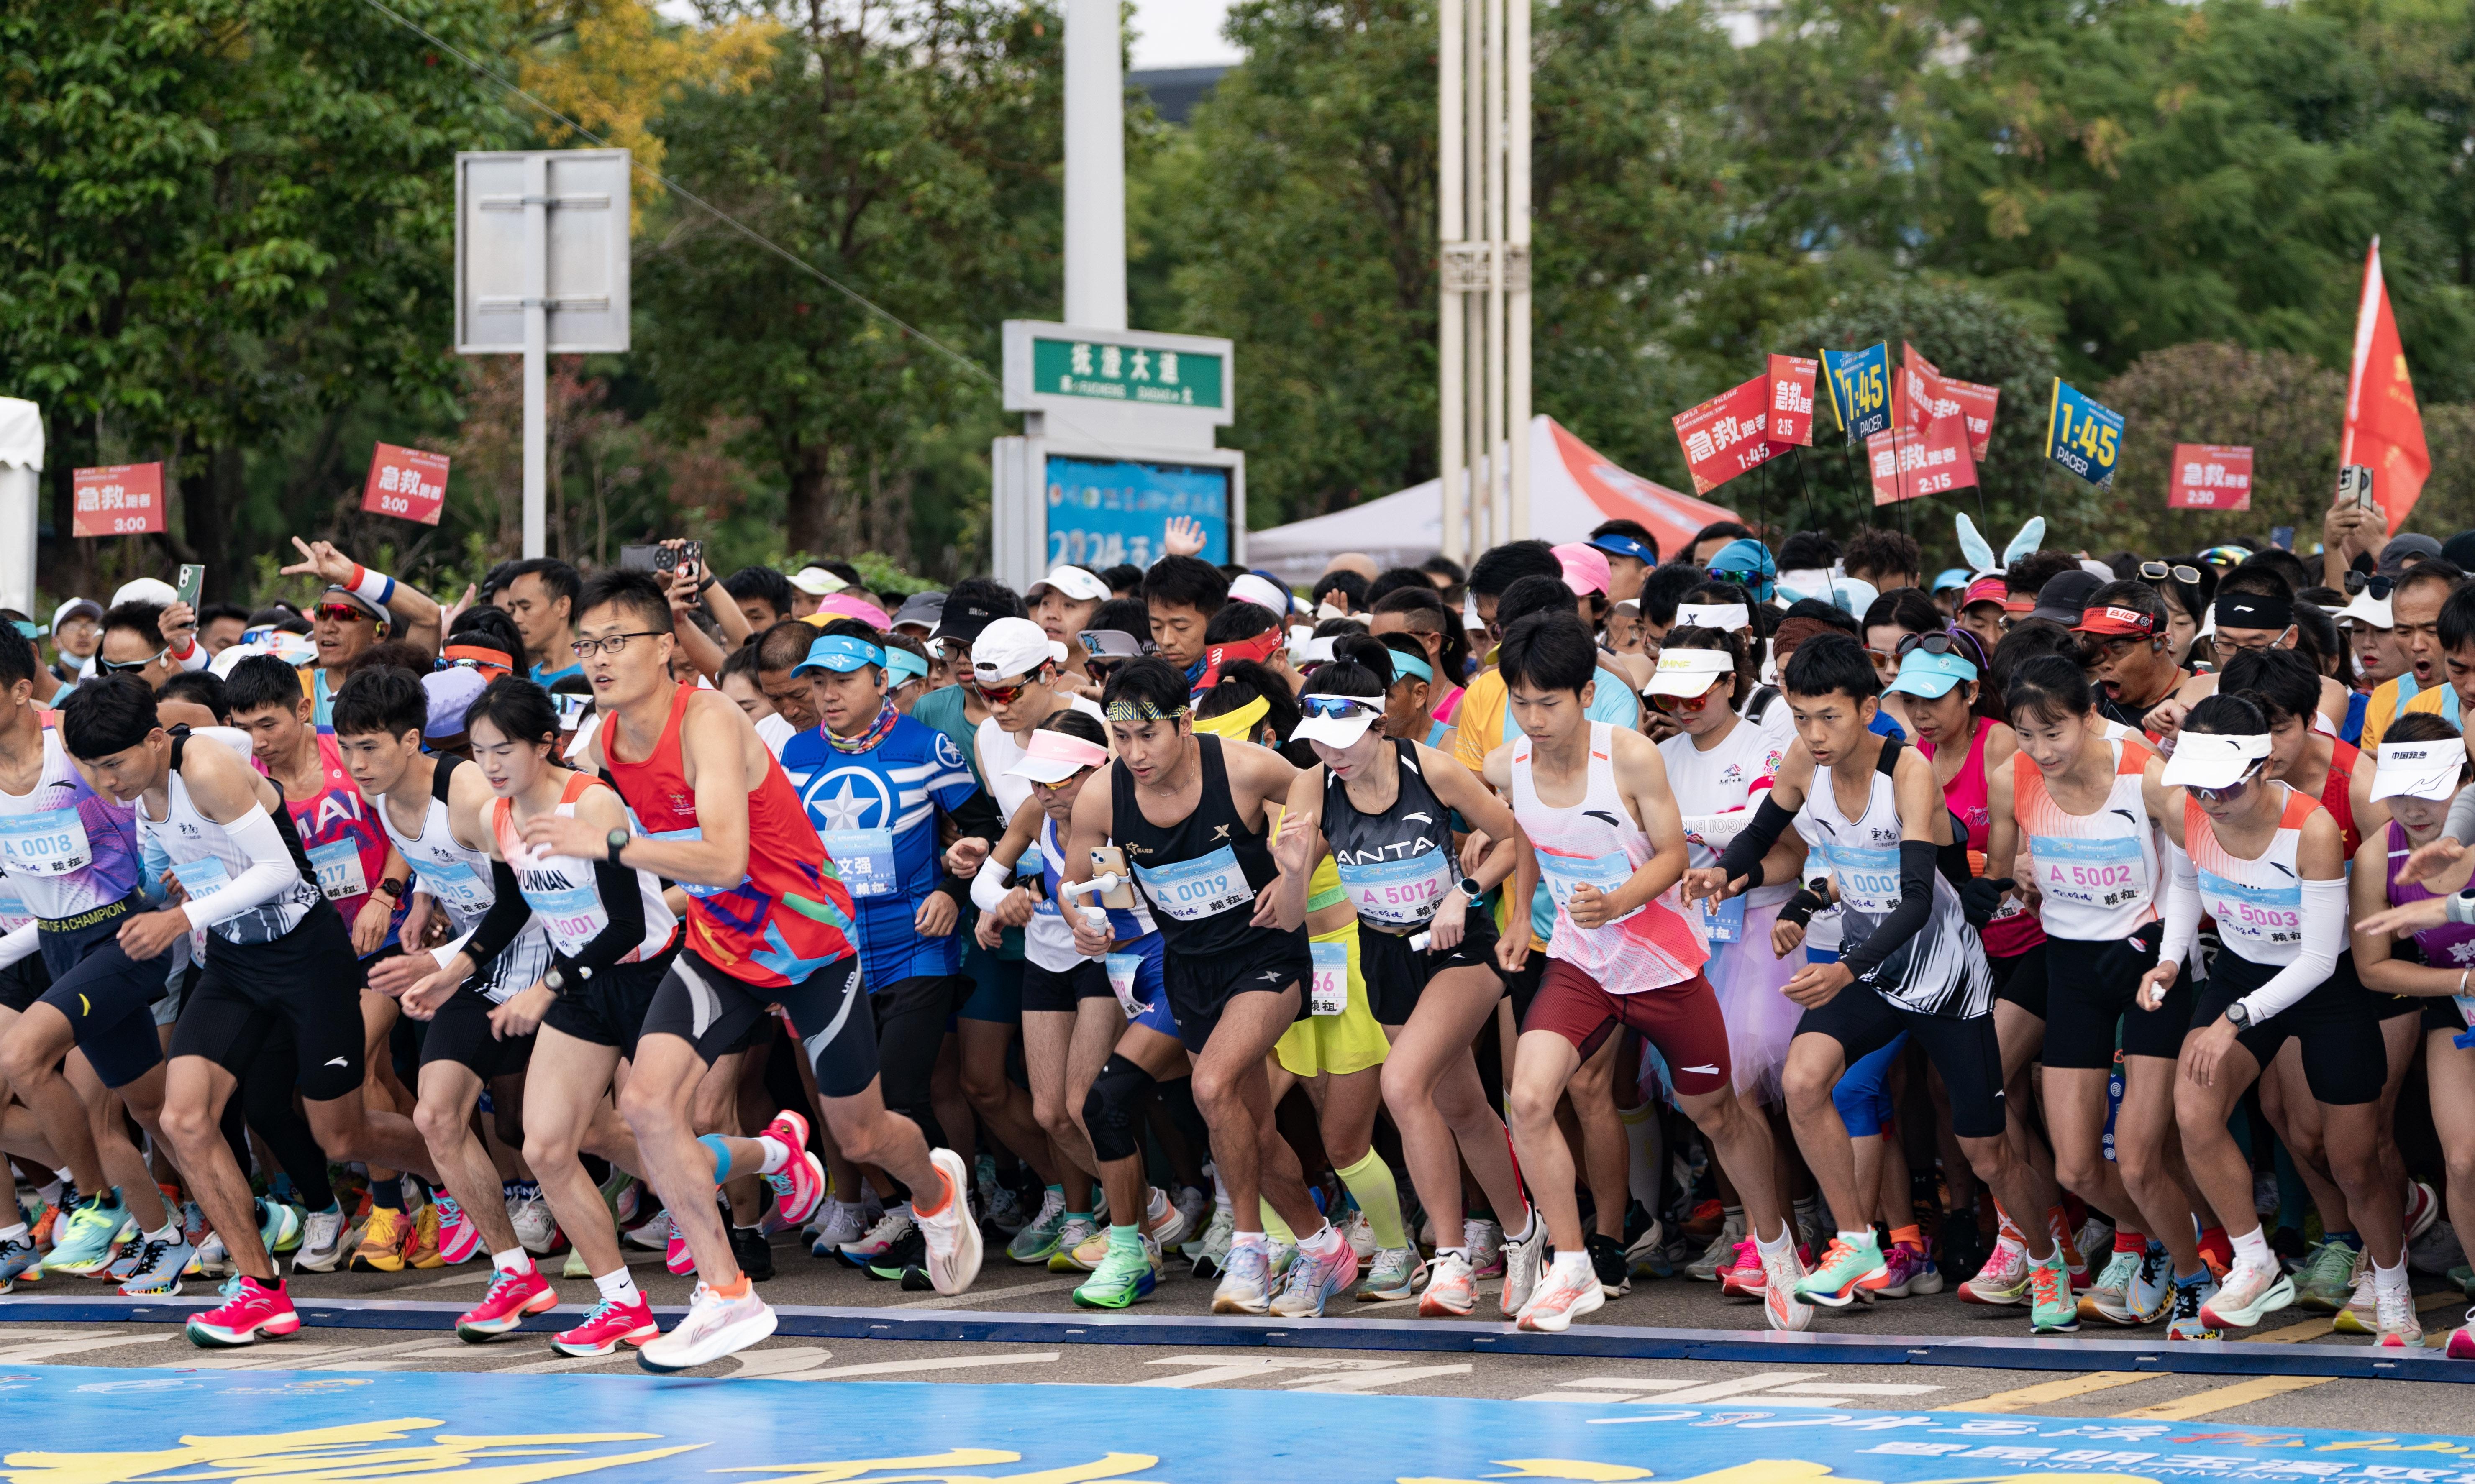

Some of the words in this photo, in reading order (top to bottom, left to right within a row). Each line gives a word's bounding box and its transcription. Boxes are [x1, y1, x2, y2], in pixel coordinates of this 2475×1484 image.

[1775, 379, 1812, 414] 急救跑者
[1845, 363, 1883, 421] 1:45
[1778, 418, 1793, 436] 2:15
[1860, 414, 1882, 437] PACER
[2062, 402, 2118, 468] 1:45
[1686, 413, 1766, 465] 急救跑者
[1737, 442, 1770, 469] 1:45
[1874, 443, 1957, 478] 急救跑者
[2057, 445, 2088, 477] PACER
[378, 465, 442, 501] 急救跑者
[1918, 473, 1952, 493] 2:15
[77, 484, 151, 512] 急救跑者
[381, 495, 408, 514] 3:00
[2187, 489, 2215, 505] 2:30
[114, 516, 146, 532] 3:00
[2109, 609, 2136, 621] BIG
[4, 840, 18, 857] A
[21, 834, 72, 856] 0018
[1337, 837, 1435, 866] ANTA
[833, 857, 872, 875] 文强
[2050, 864, 2067, 883] A
[2073, 865, 2132, 886] 5002
[517, 868, 575, 891] YUNNAN
[1157, 889, 1173, 904] A
[1177, 875, 1227, 901] 0019
[1363, 889, 1380, 904] A
[1385, 878, 1439, 904] 5012
[1555, 879, 1569, 898] A
[1838, 870, 1850, 890] A
[62, 921, 70, 932] A
[68, 901, 126, 930] CHAMPION
[2218, 901, 2234, 917] A
[2239, 903, 2299, 926] 5003
[1312, 972, 1335, 992] 66
[2003, 1461, 2092, 1470] AND
[2103, 1465, 2303, 1481] KUNMING
